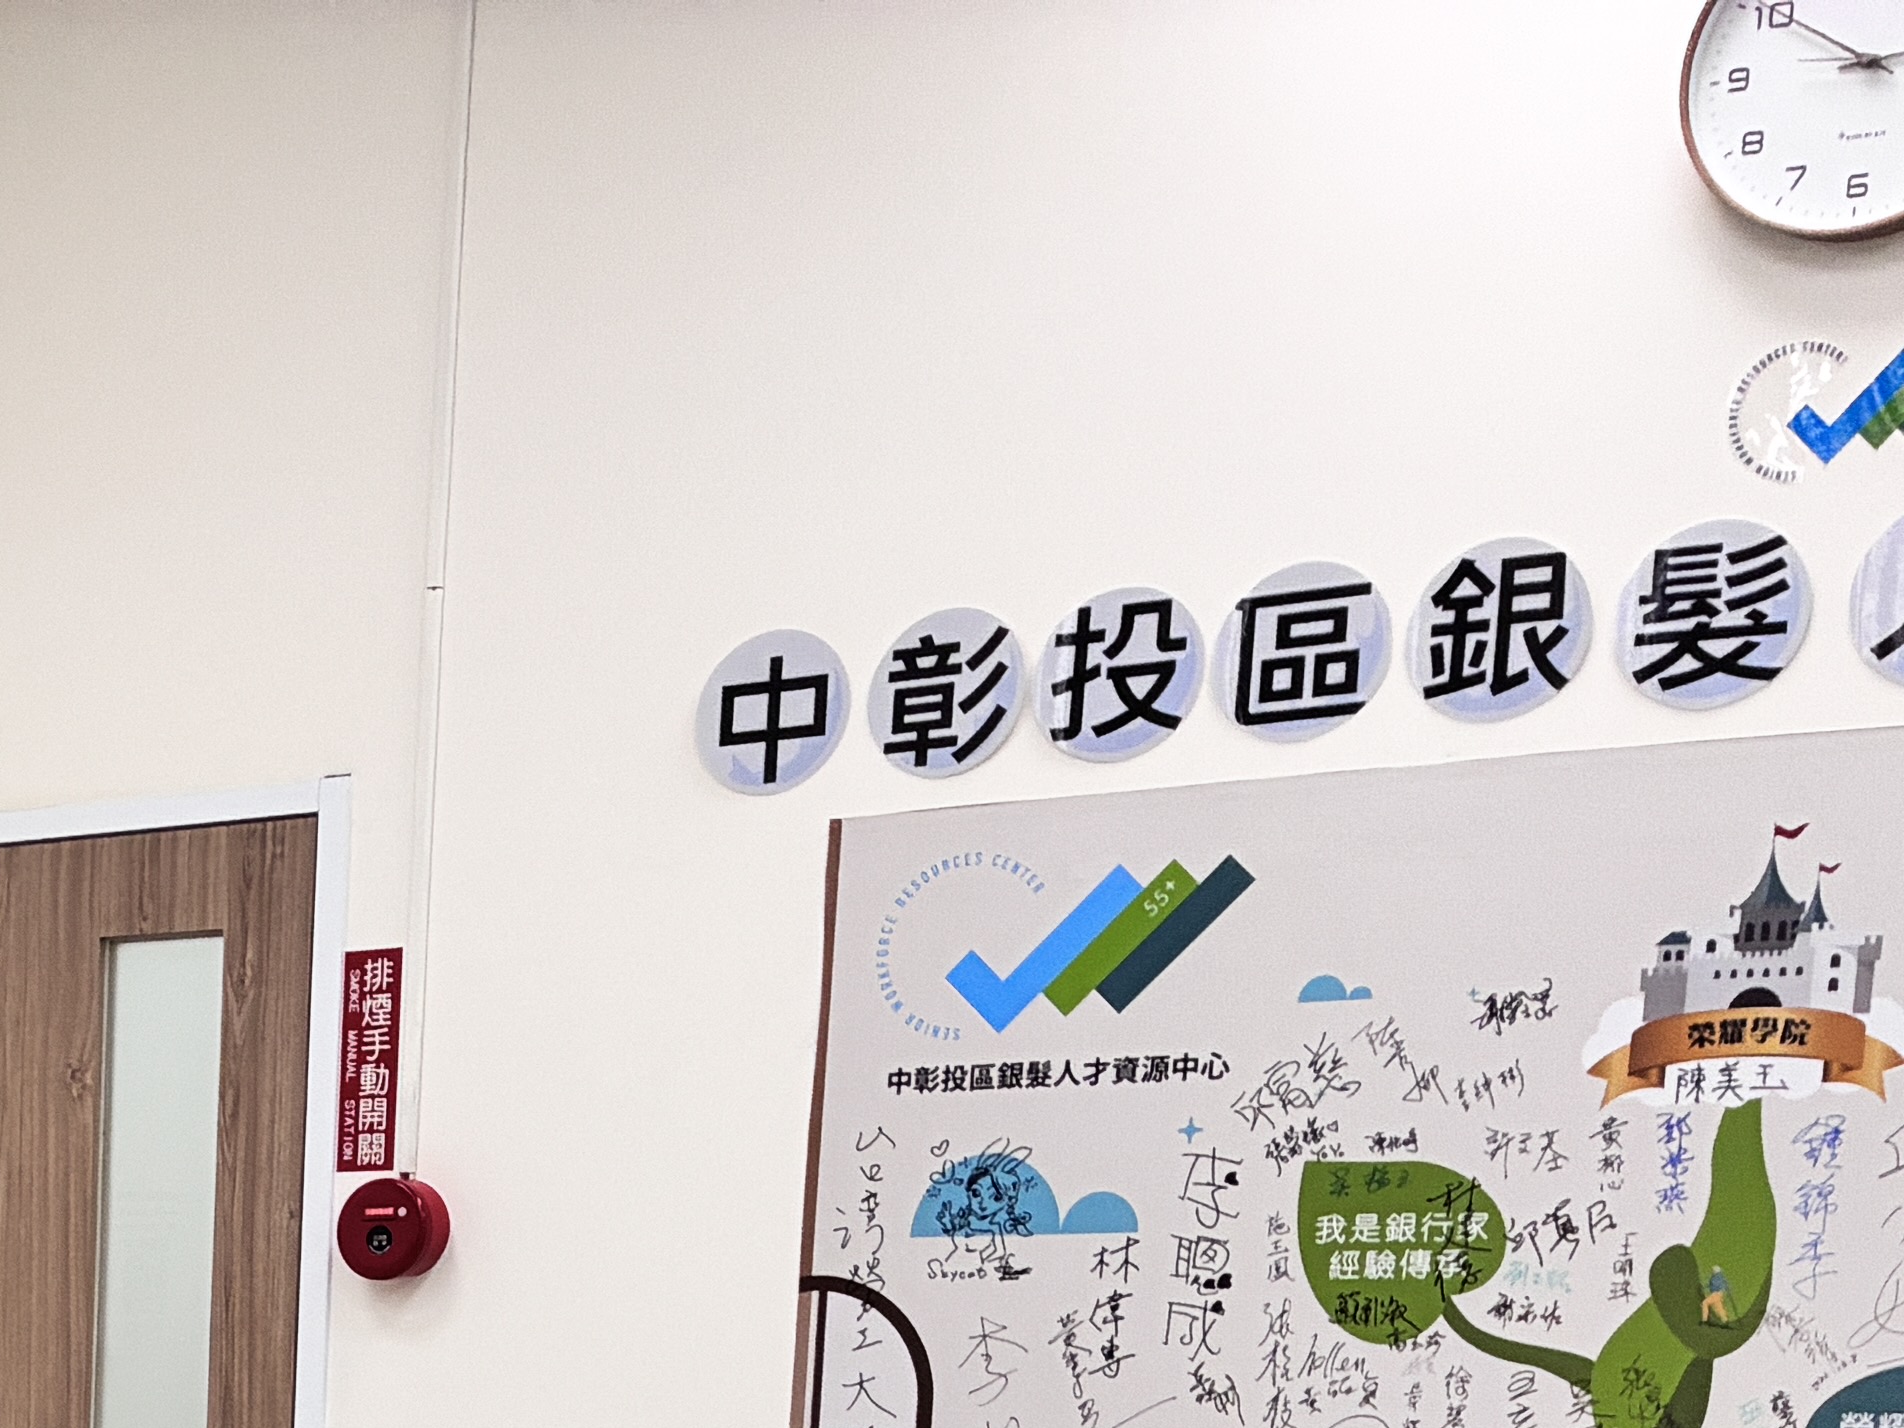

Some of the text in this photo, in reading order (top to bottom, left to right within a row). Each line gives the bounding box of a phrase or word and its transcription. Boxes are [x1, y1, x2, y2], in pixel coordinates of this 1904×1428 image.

[1727, 67, 1750, 94] 9
[1742, 131, 1764, 155] 8
[1785, 165, 1808, 191] 7
[1846, 172, 1869, 199] 6
[342, 968, 362, 1161] SMOKE MANUAL STATION
[356, 957, 394, 1167] 排煙手動開關
[886, 1052, 1232, 1097] 中彰投區銀髮人才資源中心
